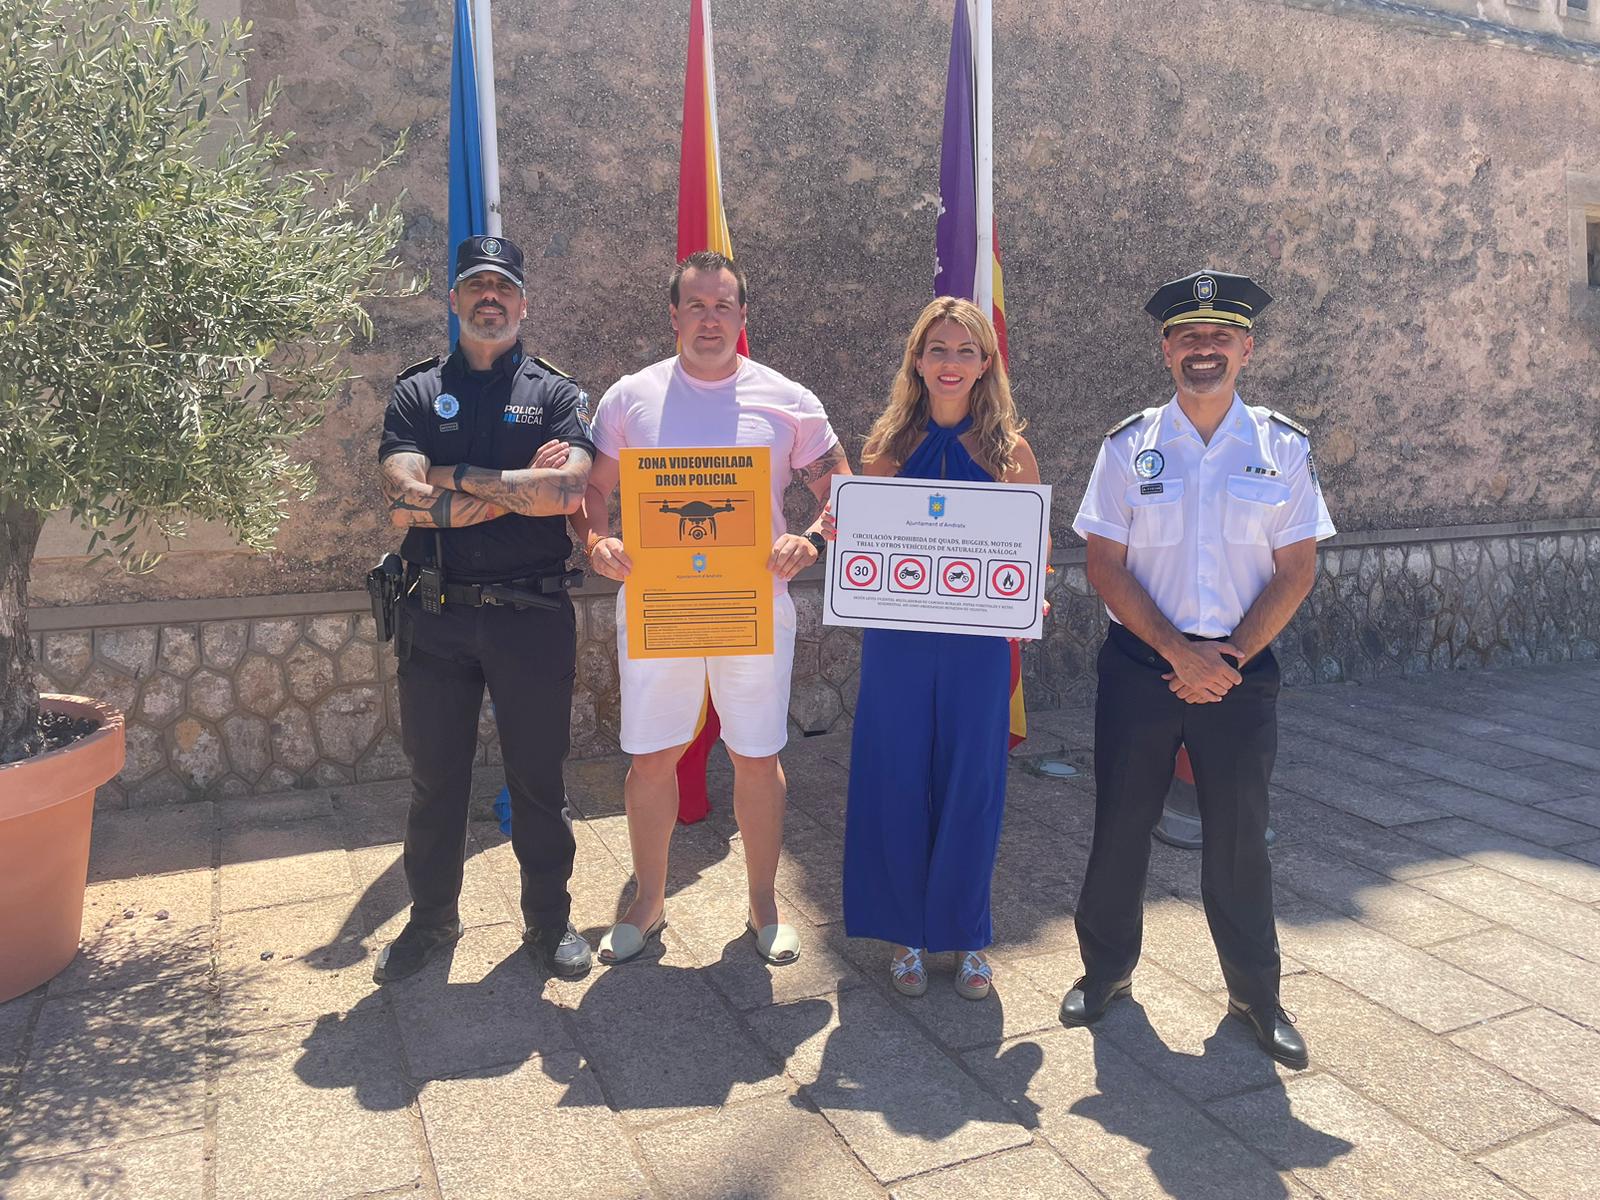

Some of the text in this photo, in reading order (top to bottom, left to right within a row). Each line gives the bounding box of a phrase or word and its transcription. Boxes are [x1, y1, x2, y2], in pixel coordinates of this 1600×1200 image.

[504, 404, 544, 416] POLICIA
[516, 415, 543, 425] LOCAL
[638, 456, 753, 470] ZONA VIDEOVIGILADA
[656, 473, 738, 486] DRON POLICIAL
[852, 532, 892, 541] CIRCULACIÓN
[946, 546, 987, 554] NATURALEZA
[854, 566, 869, 577] 30
